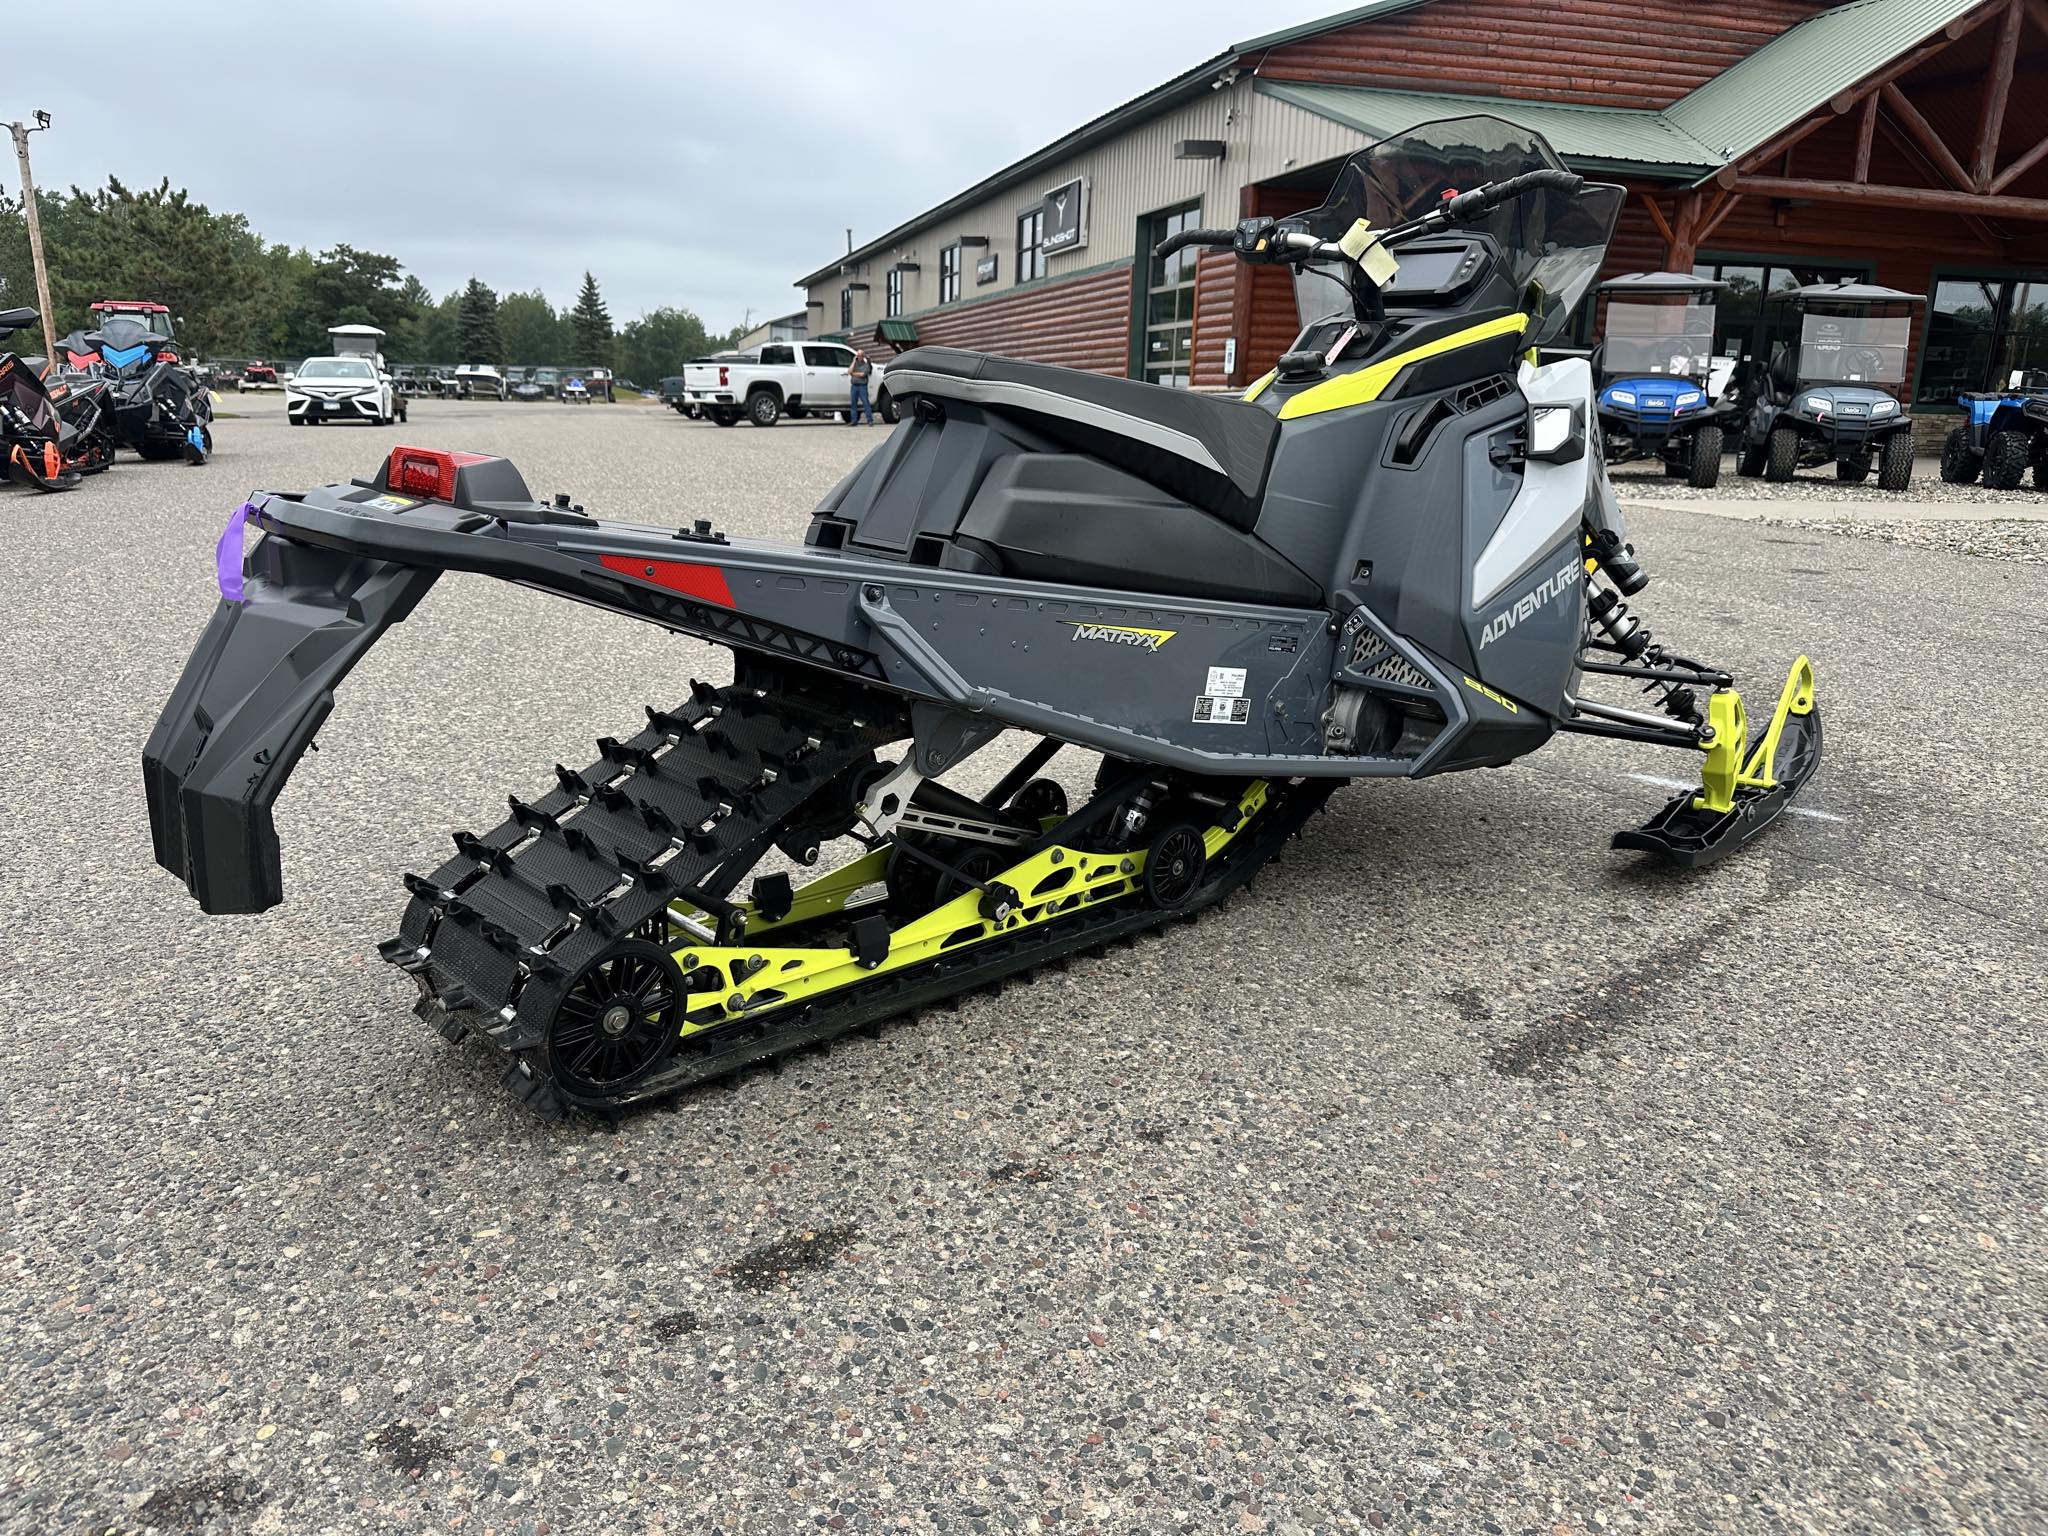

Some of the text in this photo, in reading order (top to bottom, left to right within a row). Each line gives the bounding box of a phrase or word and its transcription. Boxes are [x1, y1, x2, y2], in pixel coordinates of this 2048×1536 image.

[1479, 556, 1581, 650] ADVENTURE
[1071, 624, 1158, 653] MATRYX
[1463, 676, 1518, 714] 850
